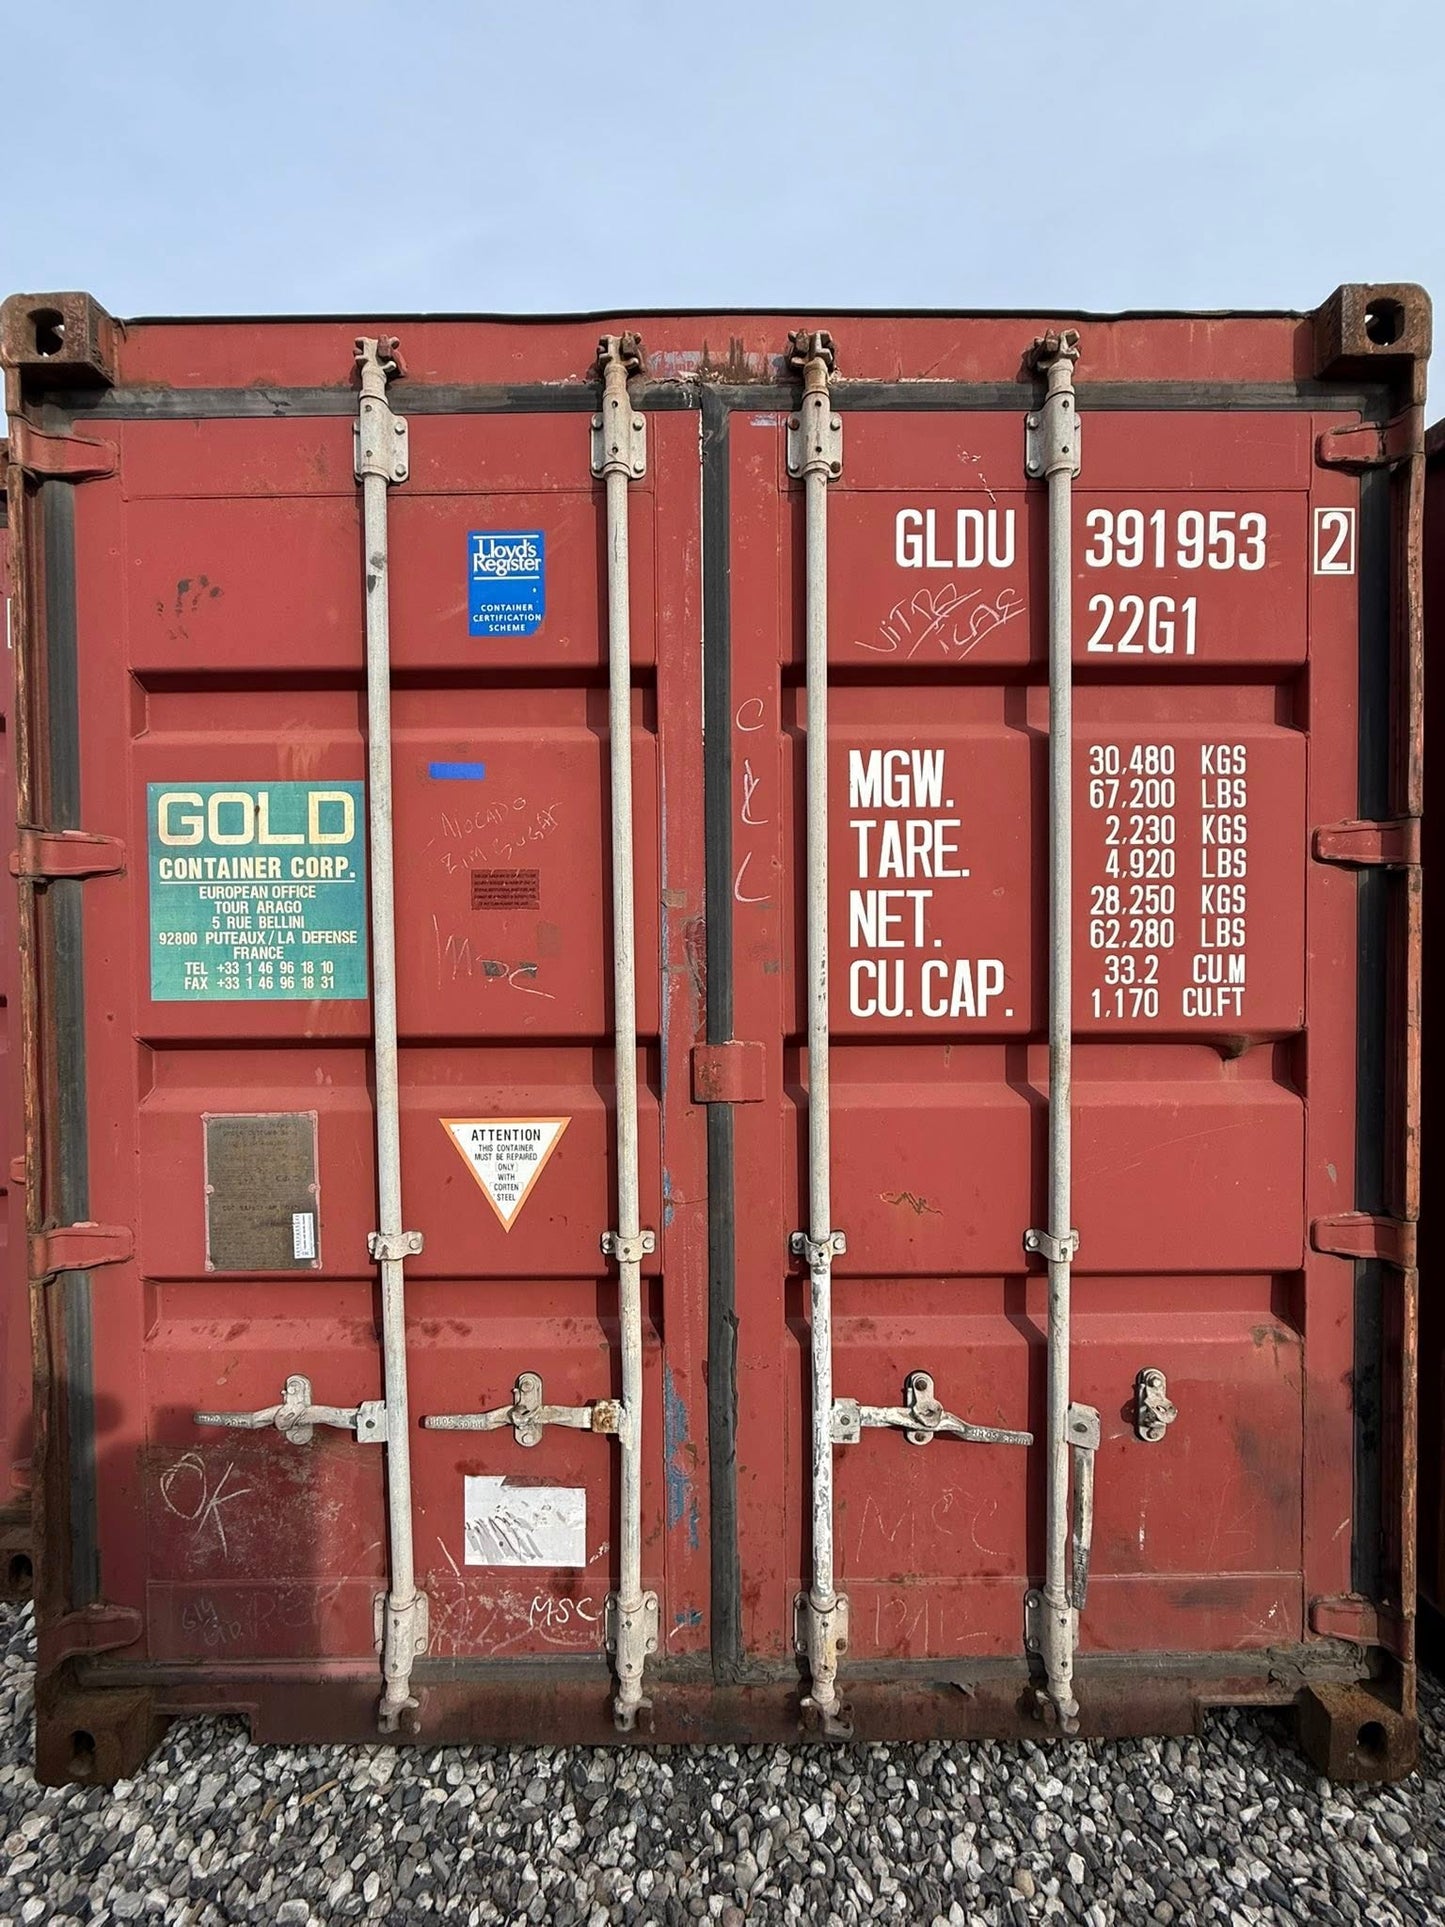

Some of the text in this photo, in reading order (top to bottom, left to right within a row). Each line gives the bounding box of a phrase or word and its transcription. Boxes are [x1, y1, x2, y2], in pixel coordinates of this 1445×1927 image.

[474, 538, 538, 561] Lloyd's
[895, 508, 1350, 572] GLDU 391953 2
[473, 553, 542, 576] Register
[473, 614, 542, 622] CERTIFICATION
[480, 604, 534, 612] CONTAINER
[1087, 594, 1197, 655] 22G1
[1089, 744, 1247, 776] 30,480 KGS
[849, 749, 954, 808] MGW.
[1089, 778, 1247, 809] 67,200 LBS
[158, 791, 355, 846] GOLD
[1105, 814, 1247, 845] 2,230 KGS
[849, 819, 970, 879] TARE.
[1105, 848, 1247, 879] 4,920 LBS
[159, 856, 356, 879] CONTAINER CORP.
[199, 886, 316, 899] EUROPEAN OFFICE
[214, 901, 302, 914] TOUR ARAGO
[1090, 884, 1246, 916] 28,250 KGS
[212, 916, 304, 928] 5 RUE BELLINI
[849, 889, 942, 948] NET.
[1090, 917, 1246, 949] 62,280 LBS
[159, 932, 197, 945] 92800
[206, 932, 266, 944] PUTEAUX
[278, 932, 295, 944] LA
[302, 931, 357, 944] DEFENSE
[233, 946, 284, 960] FRANCE
[184, 976, 334, 990] FAX +33 1 46 96 18 31
[186, 961, 334, 974] TEL +33 1 46 96 18 10
[1104, 953, 1246, 985] 33.2 CU.M
[1091, 986, 1246, 1018] 1,170 CU.FT
[472, 1129, 541, 1141] ATTENTION
[494, 1183, 519, 1191] CORTEN
[160, 1452, 252, 1559] OK
[530, 1595, 598, 1626] MSC
